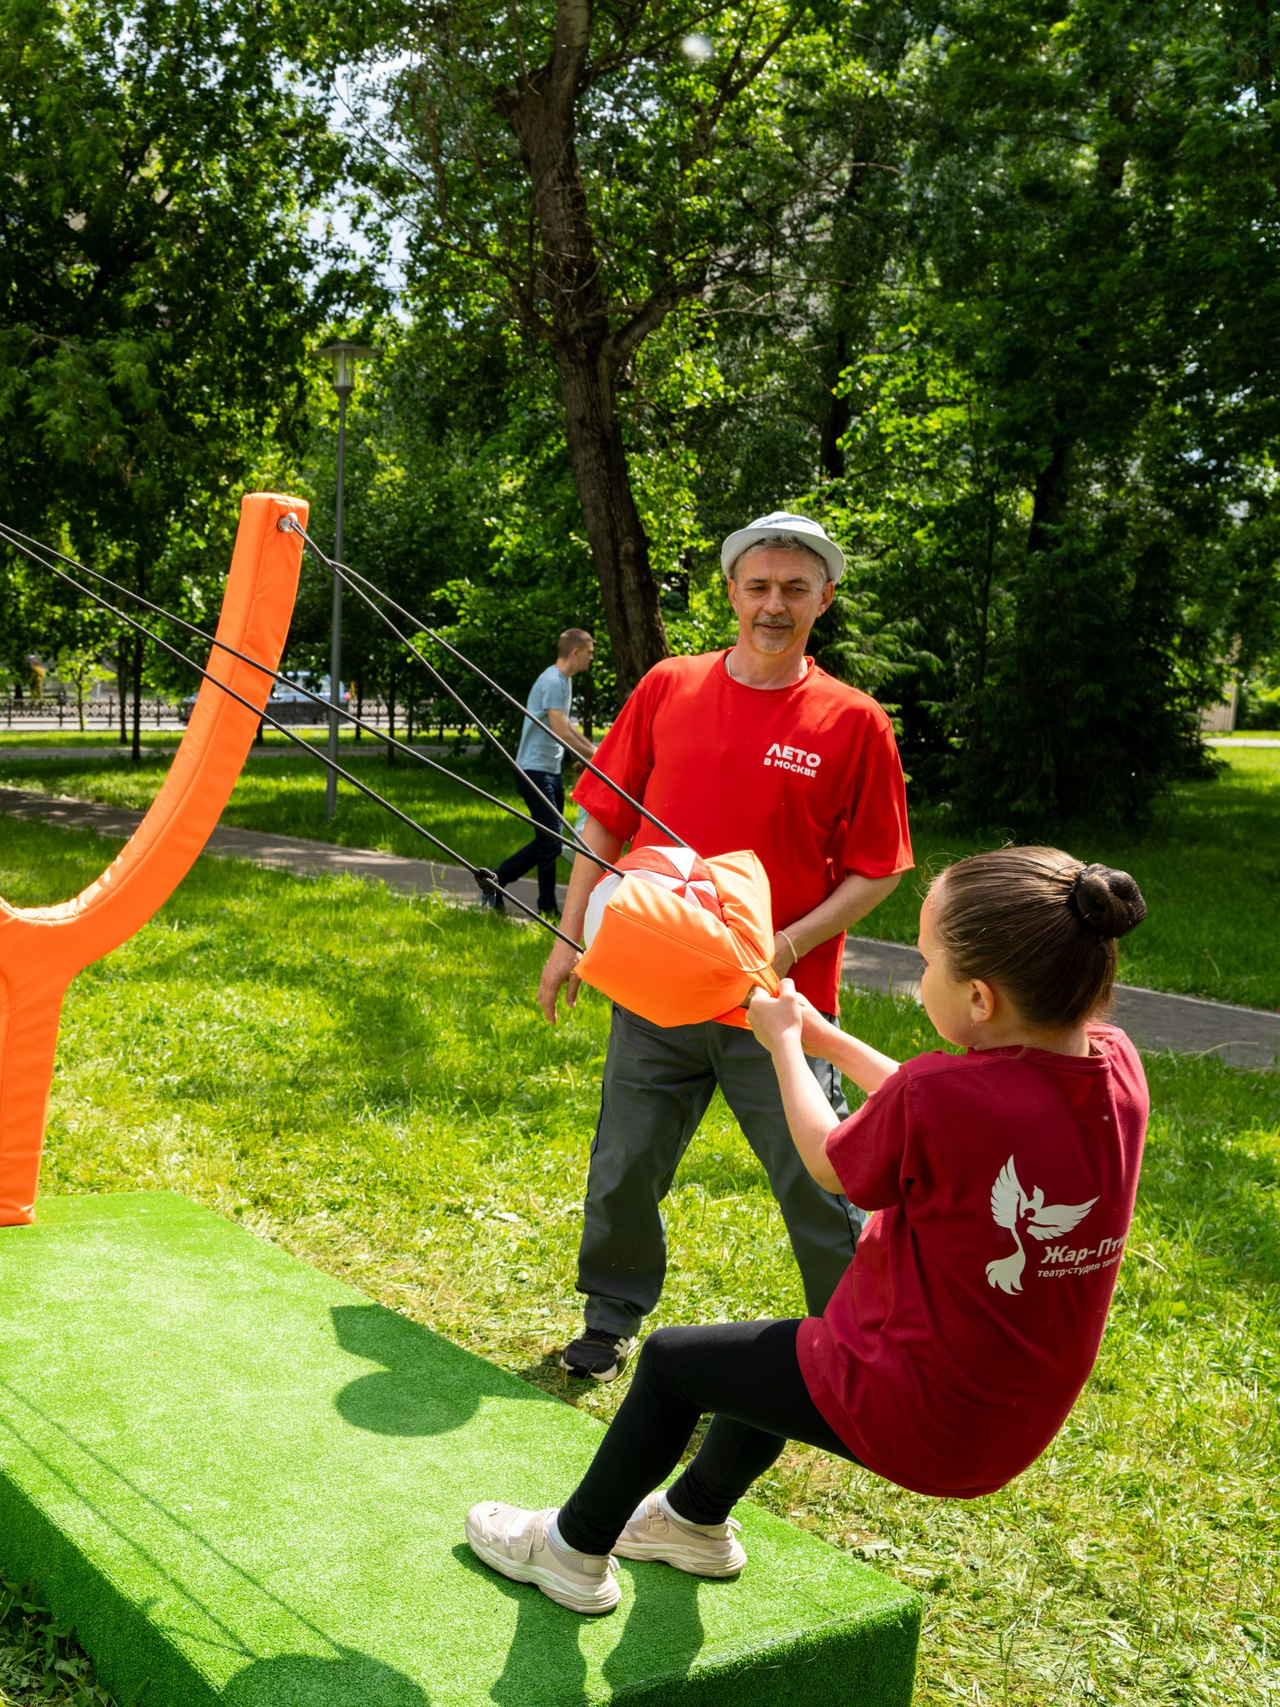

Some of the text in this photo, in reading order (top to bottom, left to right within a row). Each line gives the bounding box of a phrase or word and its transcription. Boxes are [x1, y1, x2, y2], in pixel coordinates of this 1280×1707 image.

[766, 743, 822, 768] ЛЕТО
[763, 757, 818, 778] В МОСКВЕ
